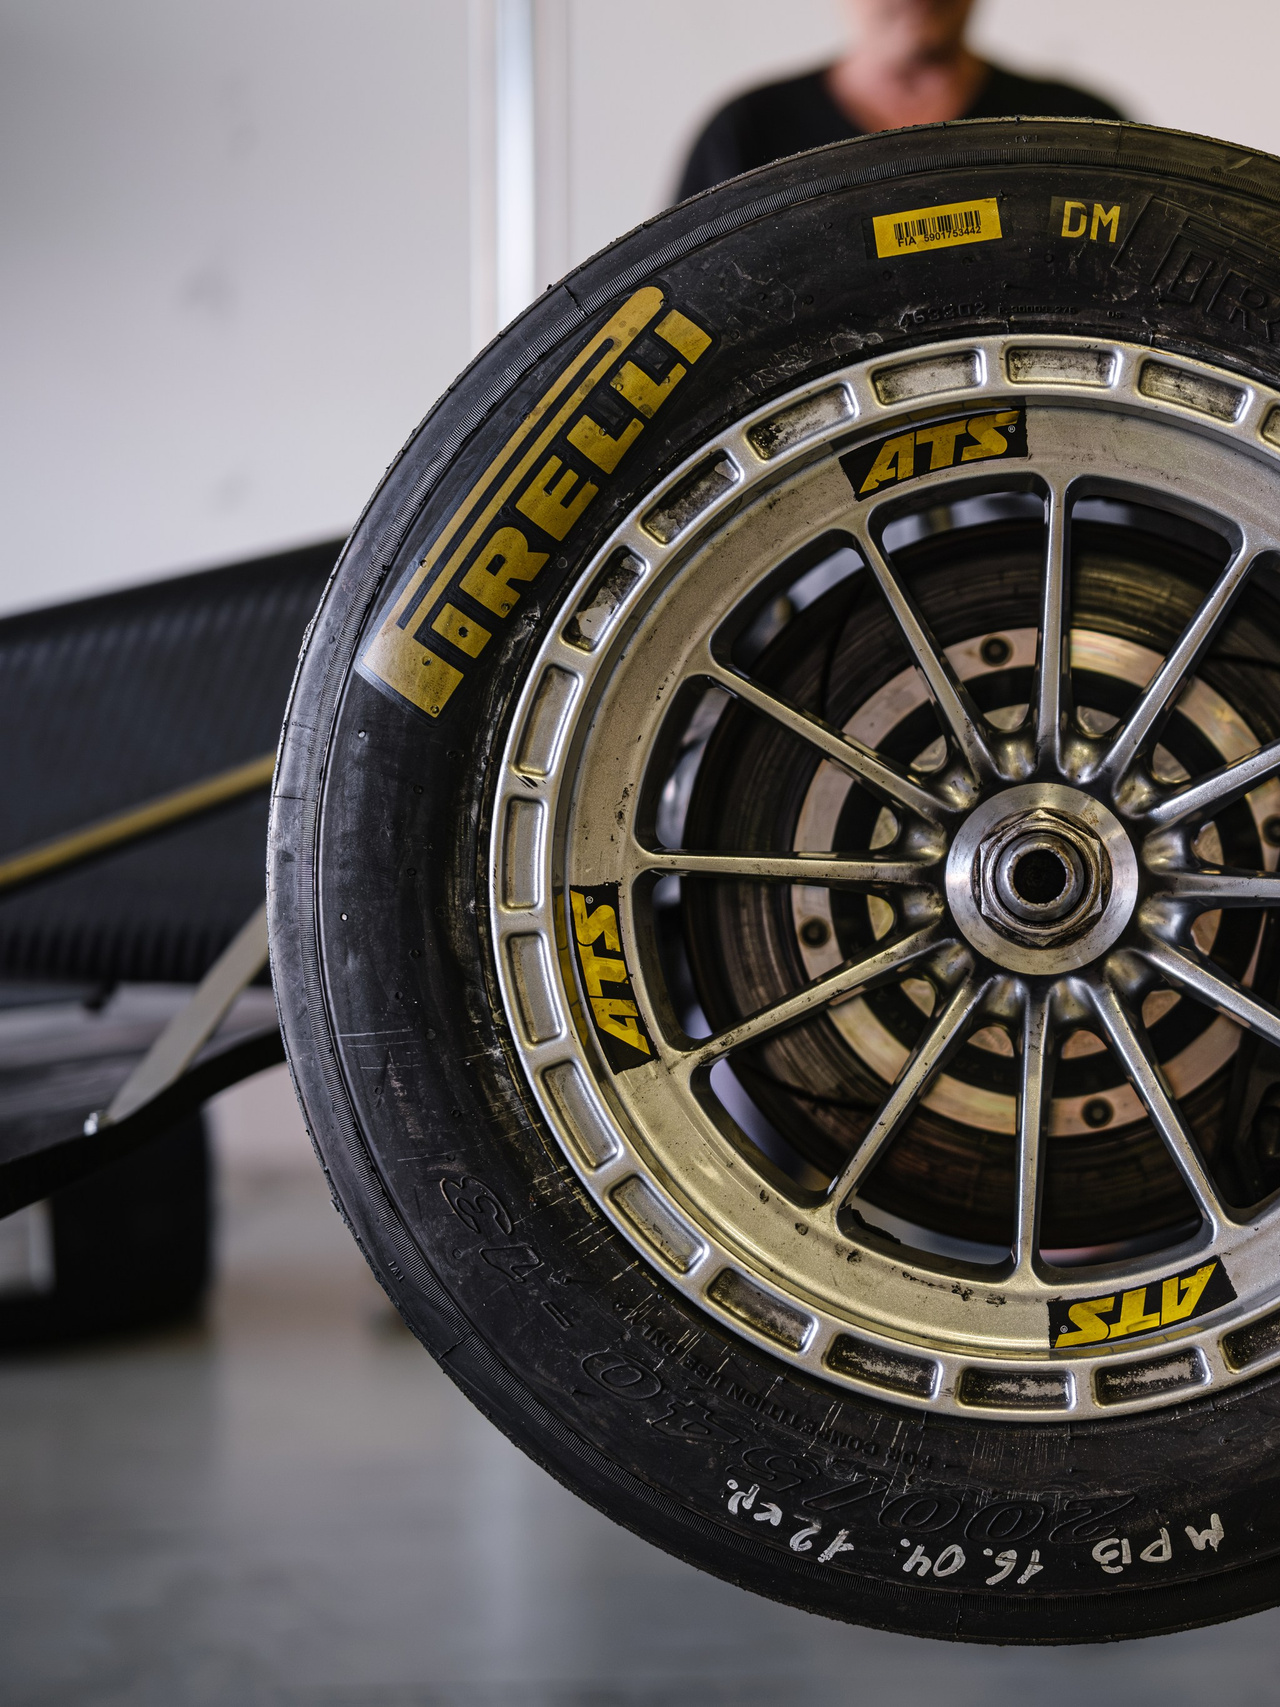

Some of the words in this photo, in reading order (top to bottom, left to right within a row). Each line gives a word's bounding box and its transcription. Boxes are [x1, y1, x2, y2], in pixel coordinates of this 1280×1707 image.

[897, 235, 917, 248] FIA
[923, 225, 982, 243] 5901753442
[1061, 201, 1121, 243] DM
[859, 410, 1021, 494] ATS
[358, 286, 713, 718] PIRELLI
[570, 889, 651, 1056] ATS
[1054, 1262, 1218, 1349] ATS
[682, 1354, 721, 1389] USE
[728, 1381, 878, 1457] COMPETITION
[885, 1446, 934, 1469] FOR
